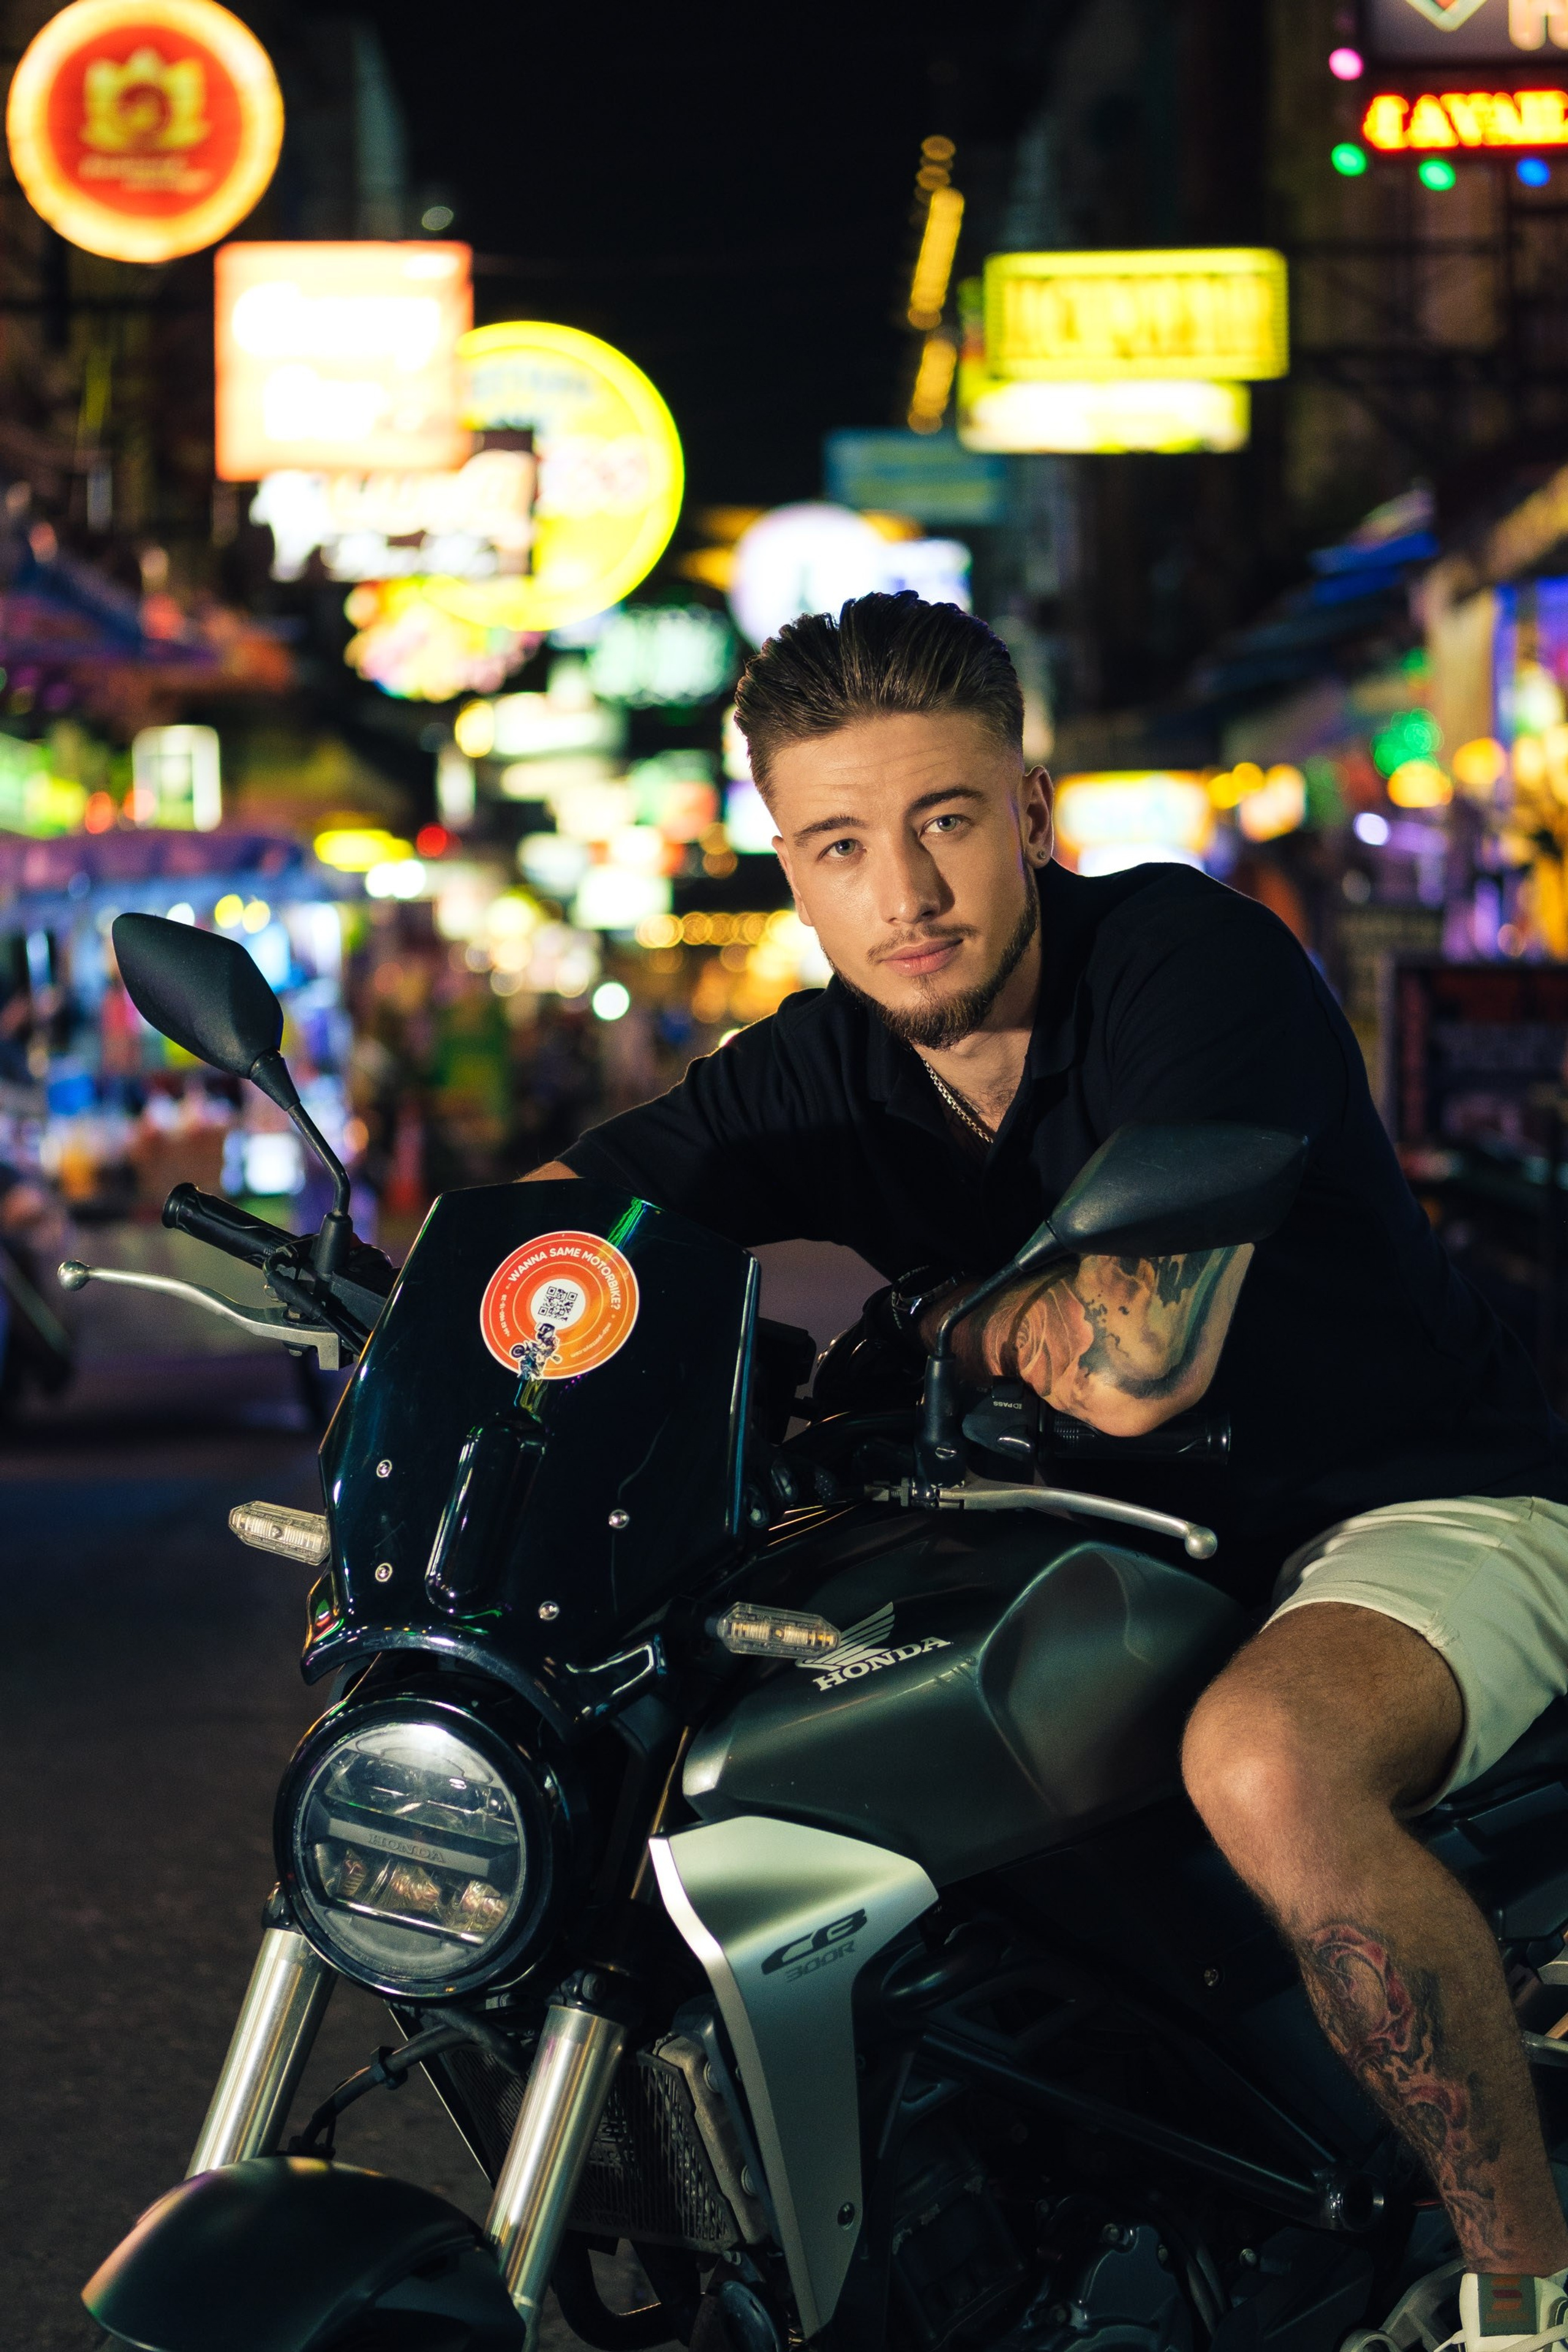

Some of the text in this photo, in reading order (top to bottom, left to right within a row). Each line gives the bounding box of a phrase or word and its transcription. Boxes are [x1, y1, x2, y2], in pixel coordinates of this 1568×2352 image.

[508, 1247, 621, 1310] WANNA SAME MOTORBIKE?
[813, 1637, 951, 1691] HONDA
[368, 1834, 445, 1863] HONDA
[761, 1908, 867, 1975] CB
[785, 1940, 855, 1983] 300R
